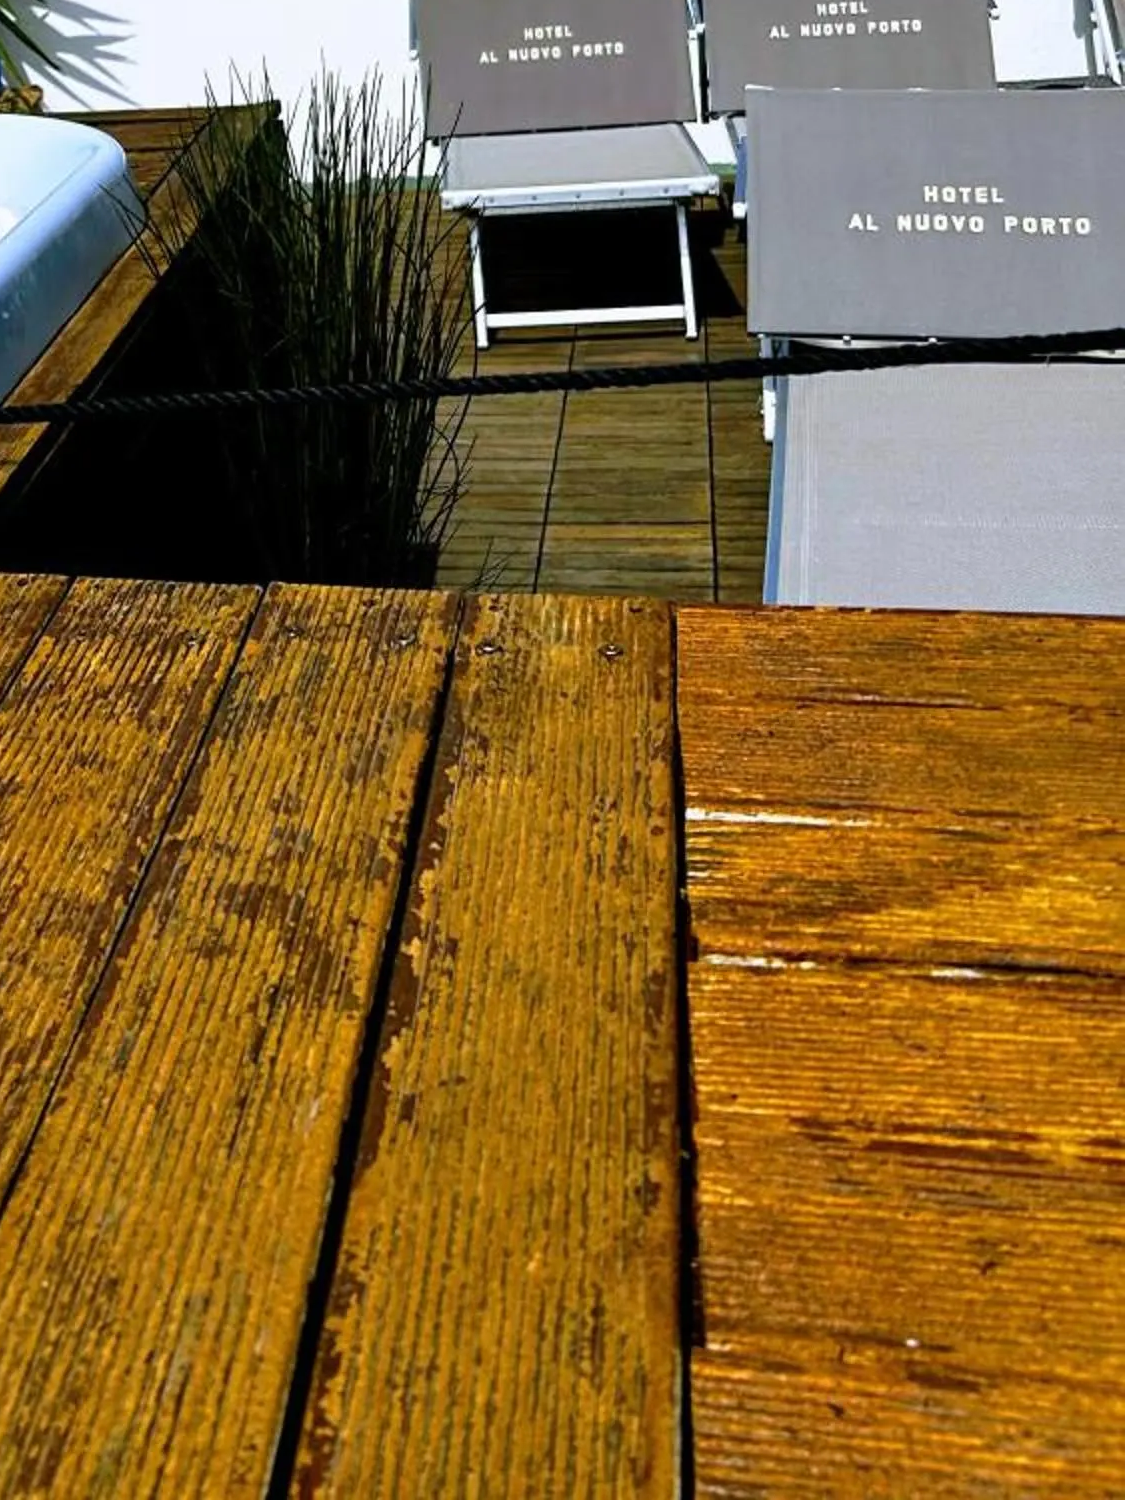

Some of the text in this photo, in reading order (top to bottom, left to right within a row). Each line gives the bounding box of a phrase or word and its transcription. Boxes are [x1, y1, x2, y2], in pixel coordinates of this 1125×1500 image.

[816, 0, 869, 17] HOTEL
[523, 25, 573, 41] HOTEL
[769, 19, 922, 39] AL NUOVO PORTO
[479, 41, 624, 64] AL NUOVO PORTO
[923, 185, 1004, 204] HOTEL
[848, 213, 1091, 235] AL NUOVO PORTO
